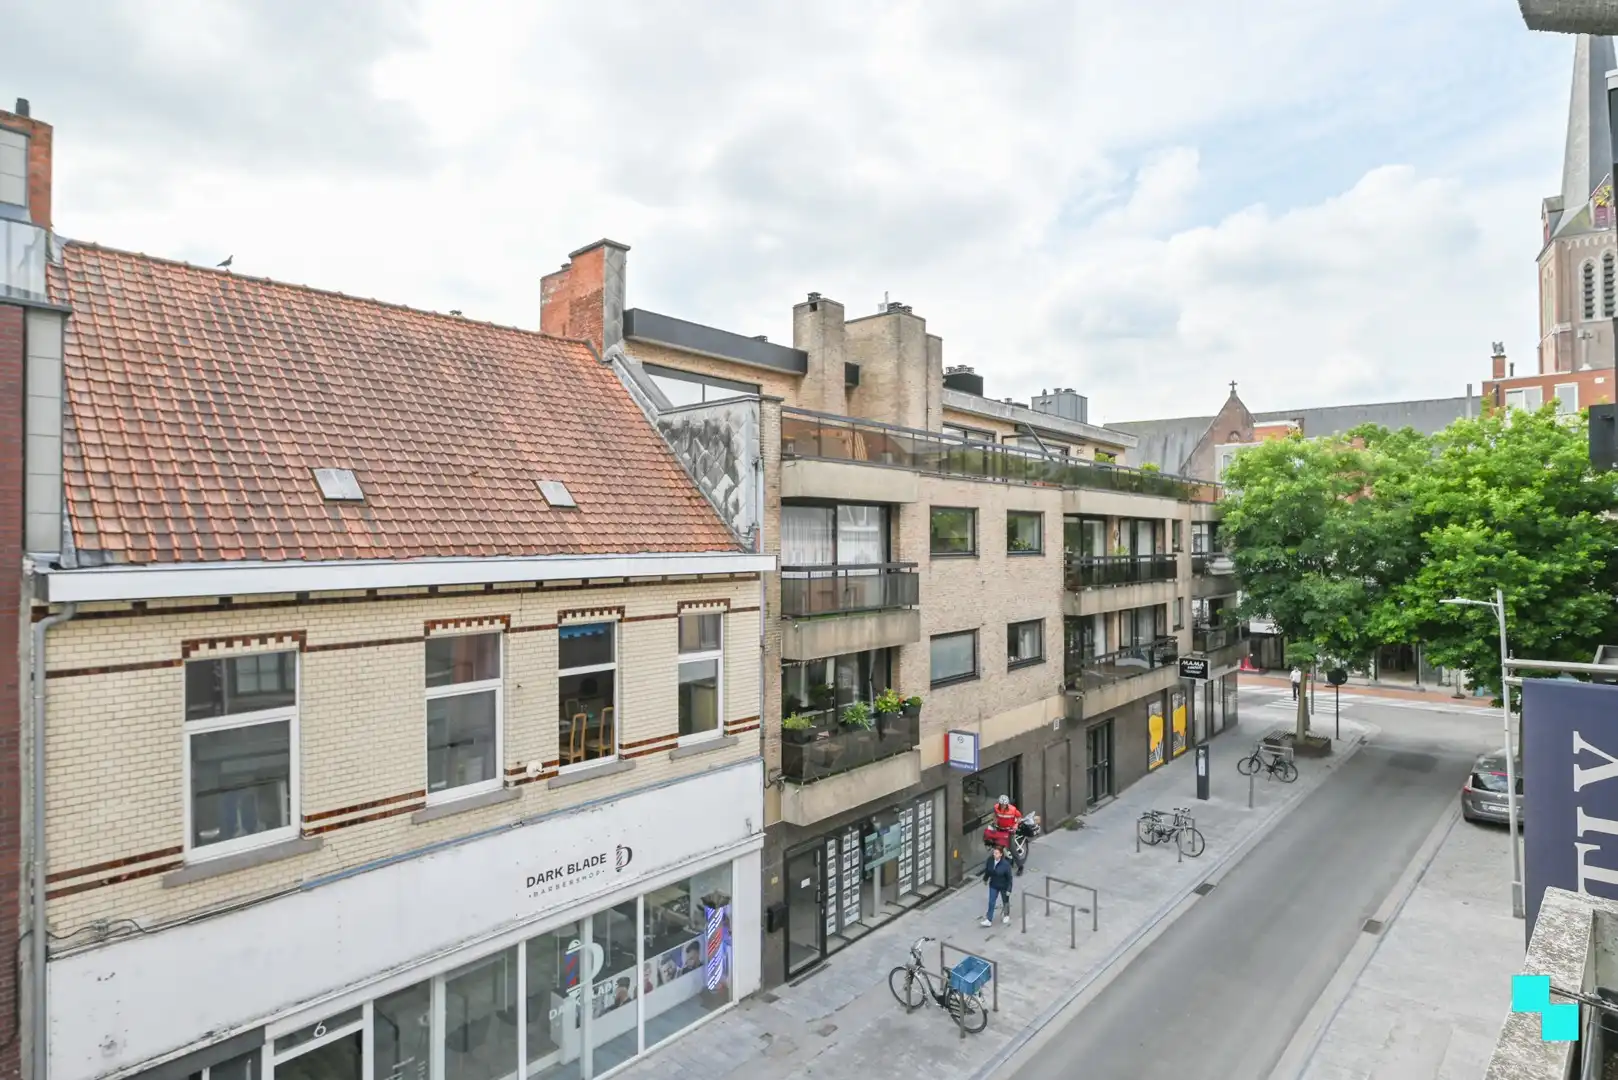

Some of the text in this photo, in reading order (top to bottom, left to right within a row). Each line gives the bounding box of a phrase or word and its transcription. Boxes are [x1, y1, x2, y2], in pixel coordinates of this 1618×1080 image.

[526, 853, 607, 888] DARK BLADE
[313, 1021, 327, 1038] 6
